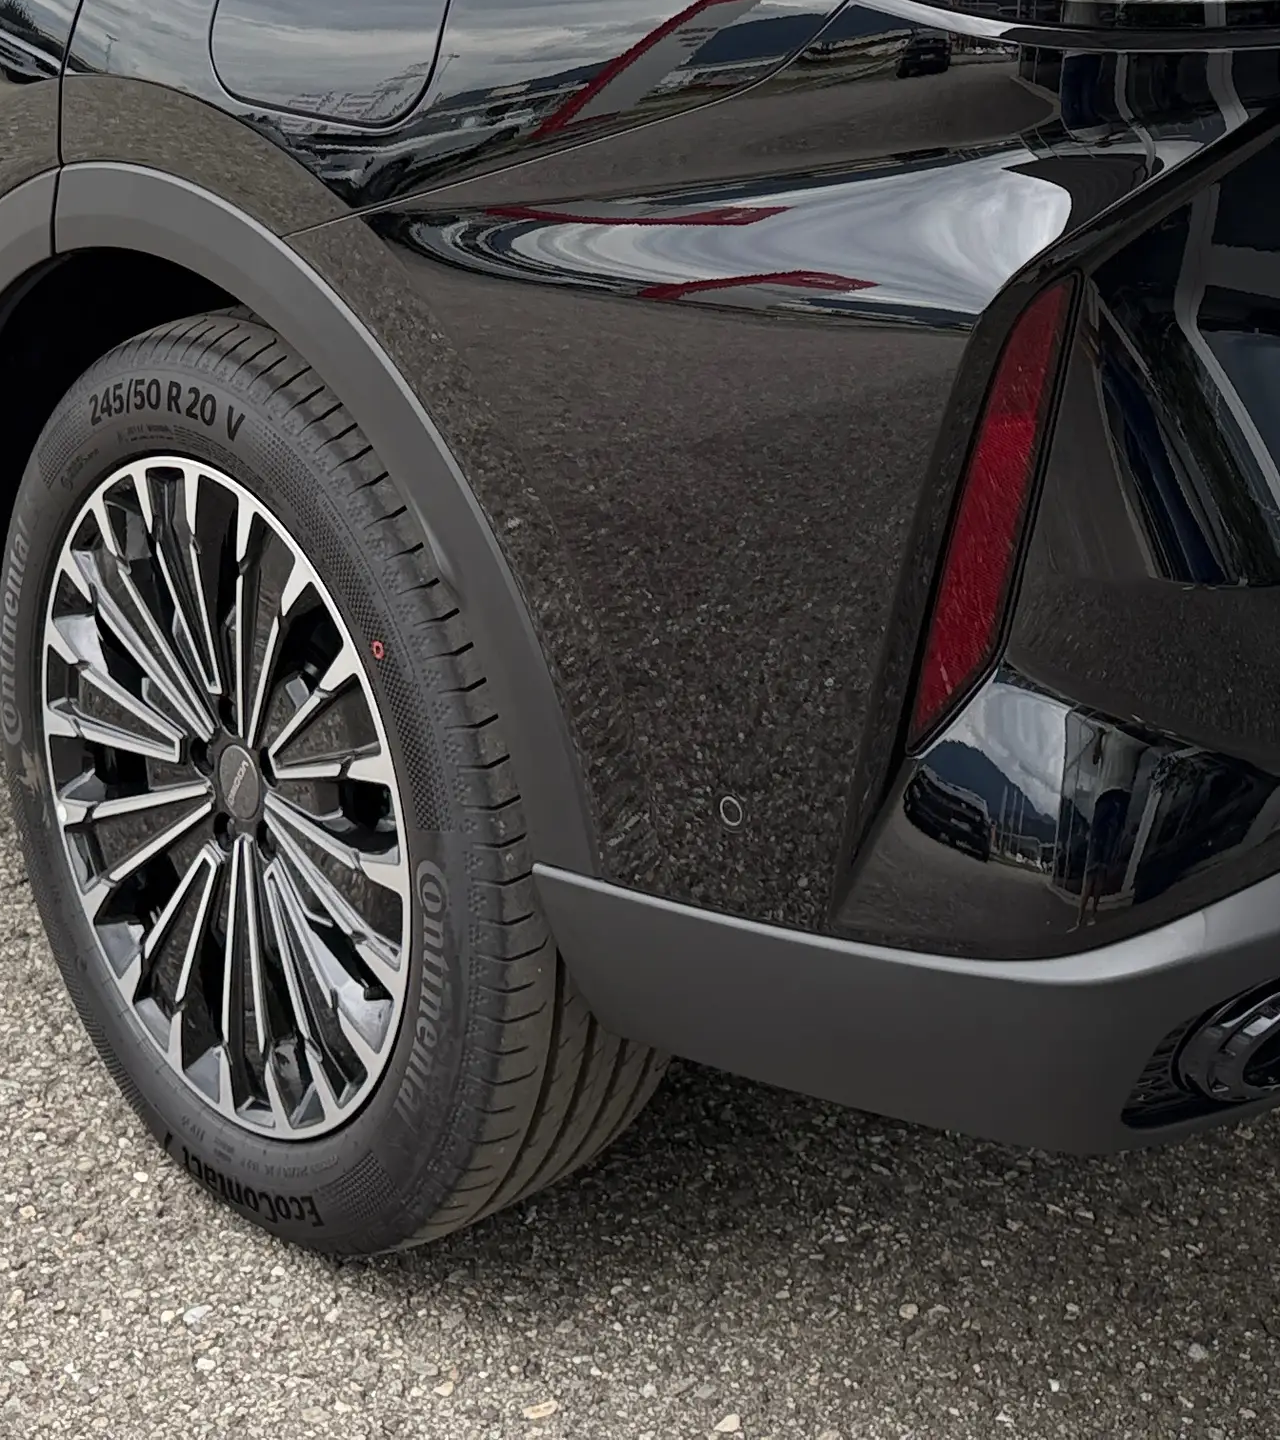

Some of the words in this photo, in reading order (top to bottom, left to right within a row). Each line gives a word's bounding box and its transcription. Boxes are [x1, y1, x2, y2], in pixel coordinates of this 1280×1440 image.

[88, 377, 162, 427] 245/50
[166, 379, 182, 415] R
[185, 386, 217, 427] 20
[226, 403, 246, 443] V
[0, 514, 33, 745] Continental
[392, 859, 450, 1133] Continental
[182, 1144, 326, 1228] EcoContact
